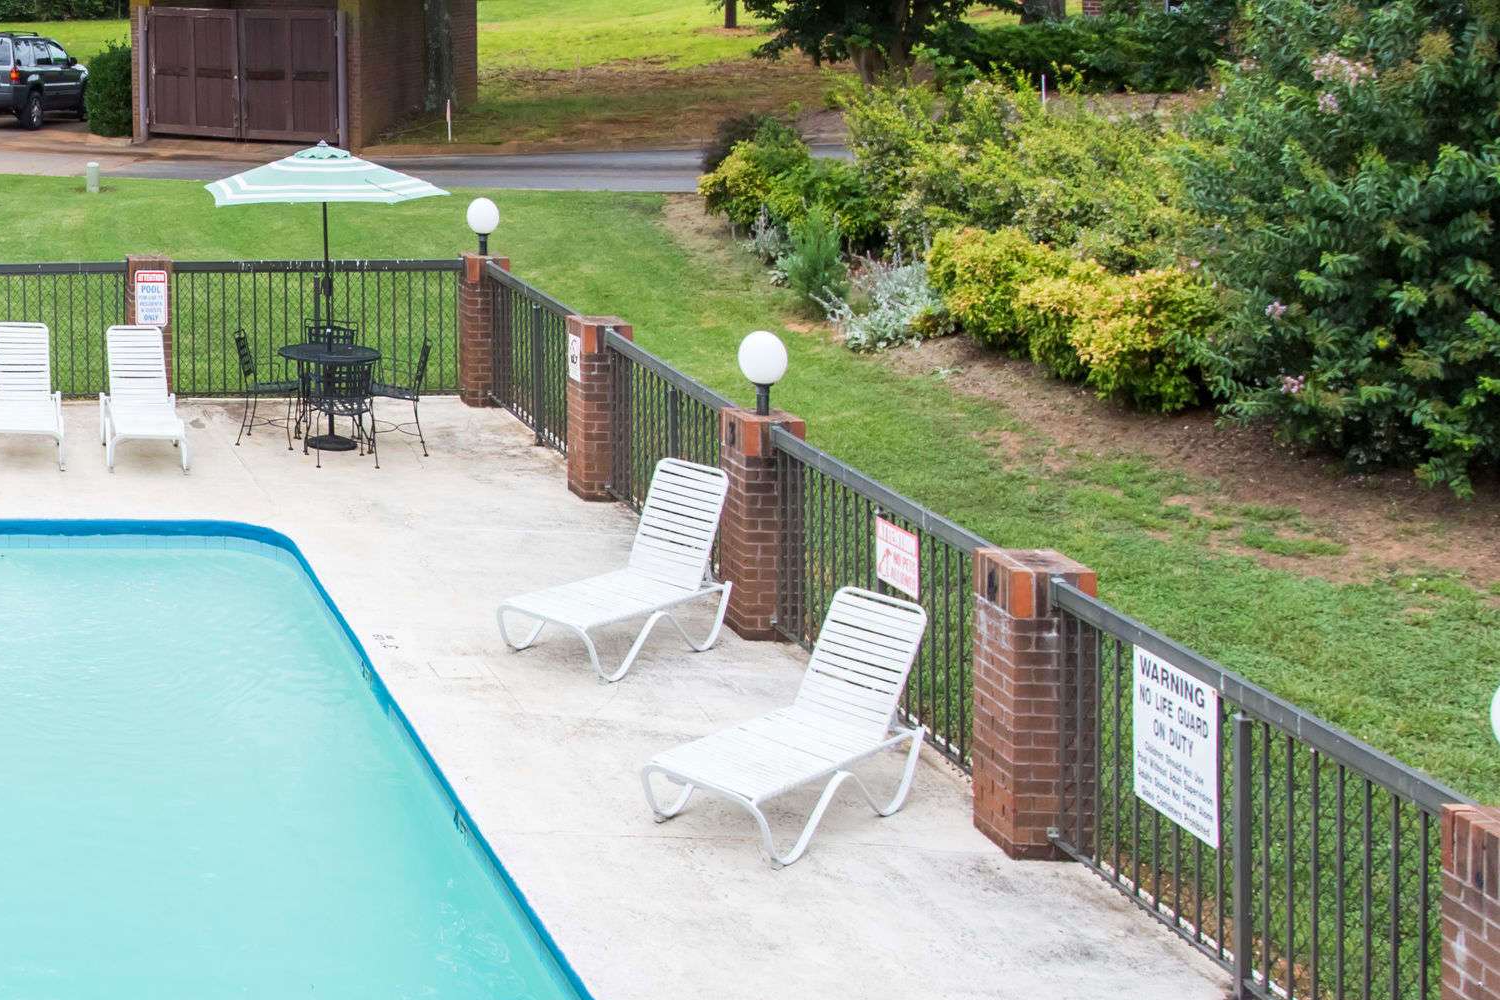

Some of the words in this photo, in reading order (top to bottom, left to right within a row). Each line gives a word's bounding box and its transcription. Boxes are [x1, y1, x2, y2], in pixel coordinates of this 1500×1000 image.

[141, 285, 161, 293] POOL
[1140, 655, 1205, 709] WARNING
[1140, 684, 1151, 705] NO
[1156, 693, 1172, 719] LIFE
[1178, 706, 1208, 739] GUARD
[1153, 719, 1165, 740] ON
[1170, 728, 1193, 757] DUTY
